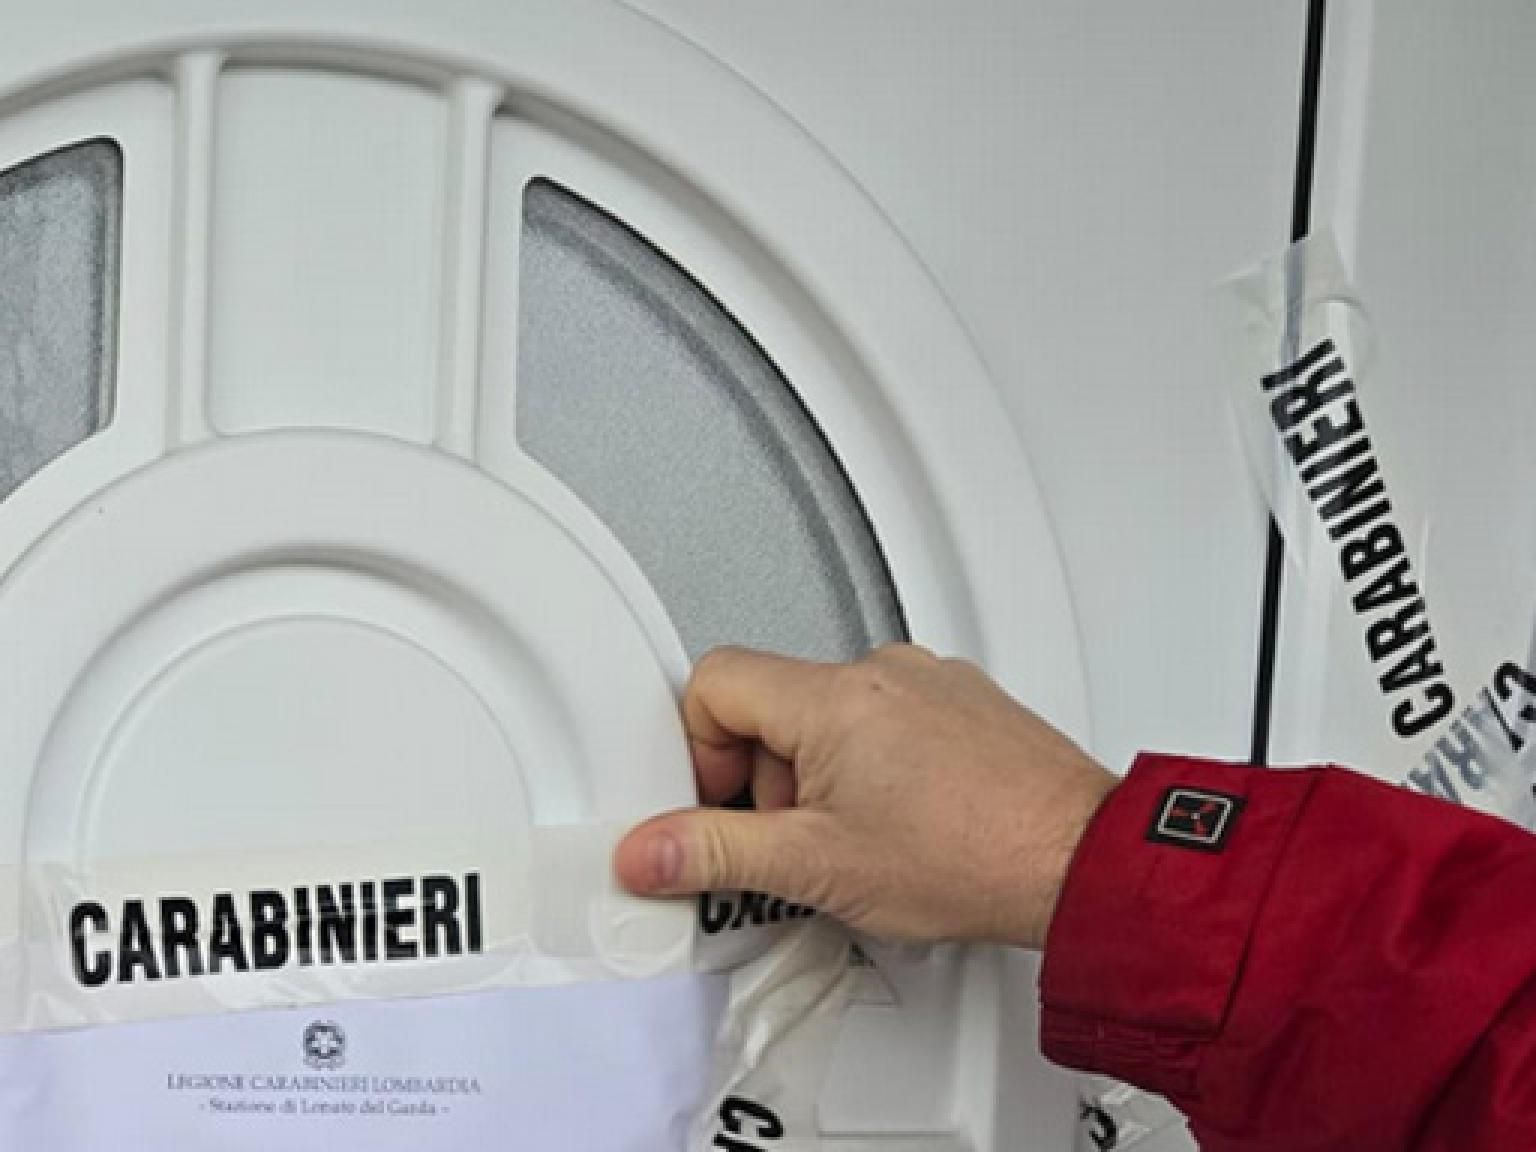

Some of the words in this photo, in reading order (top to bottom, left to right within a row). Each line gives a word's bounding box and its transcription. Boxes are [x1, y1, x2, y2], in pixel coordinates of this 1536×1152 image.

[1261, 338, 1456, 738] CARABINIERI
[70, 872, 483, 988] CARABINIERI
[167, 1074, 243, 1090] LEGIONE
[250, 1074, 369, 1091] CARABINIERI
[371, 1077, 480, 1094] LOMBARDIA
[209, 1098, 276, 1114] Stazione
[386, 1100, 436, 1116] Garda
